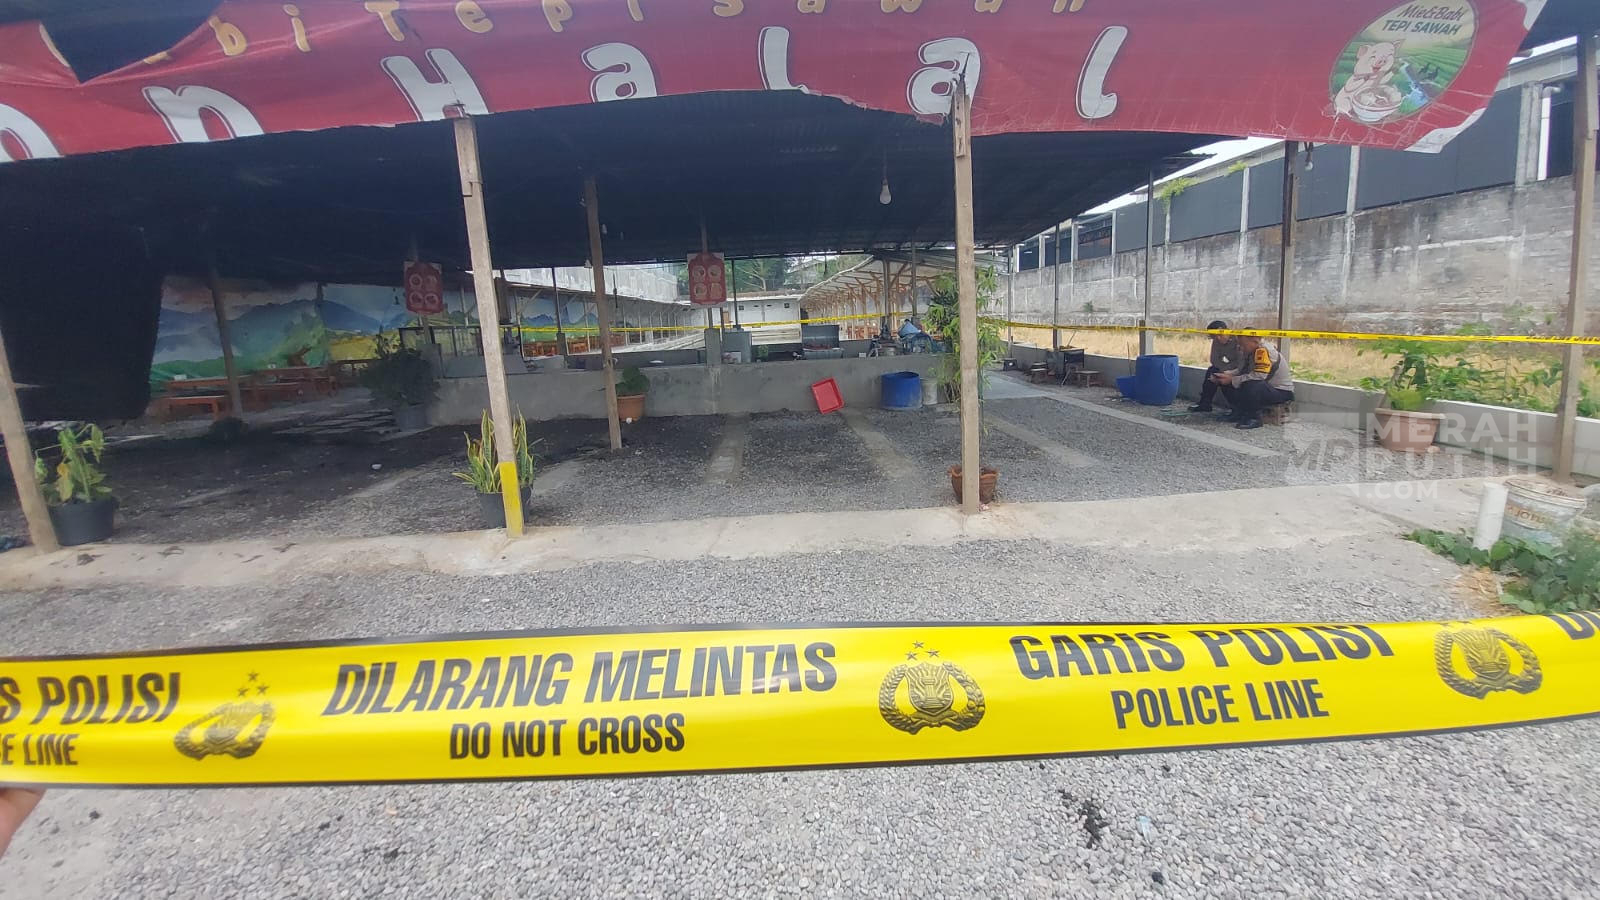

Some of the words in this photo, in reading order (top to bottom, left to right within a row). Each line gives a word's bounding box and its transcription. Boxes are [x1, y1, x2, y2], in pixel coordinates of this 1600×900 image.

[1382, 20, 1411, 33] TEPI
[1411, 21, 1462, 36] SAWAH
[1009, 631, 1185, 680] GARIS
[1188, 624, 1394, 667] POLISI
[29, 672, 181, 725] POLISI
[320, 652, 574, 716] DILARANG
[583, 642, 838, 702] MELINTAS
[1111, 684, 1239, 729] POLICE
[1245, 678, 1330, 722] LINE
[0, 733, 16, 766] E
[23, 733, 80, 766] LINE
[450, 722, 491, 759] DO
[502, 719, 567, 758] NOT
[577, 713, 685, 756] CROSS
